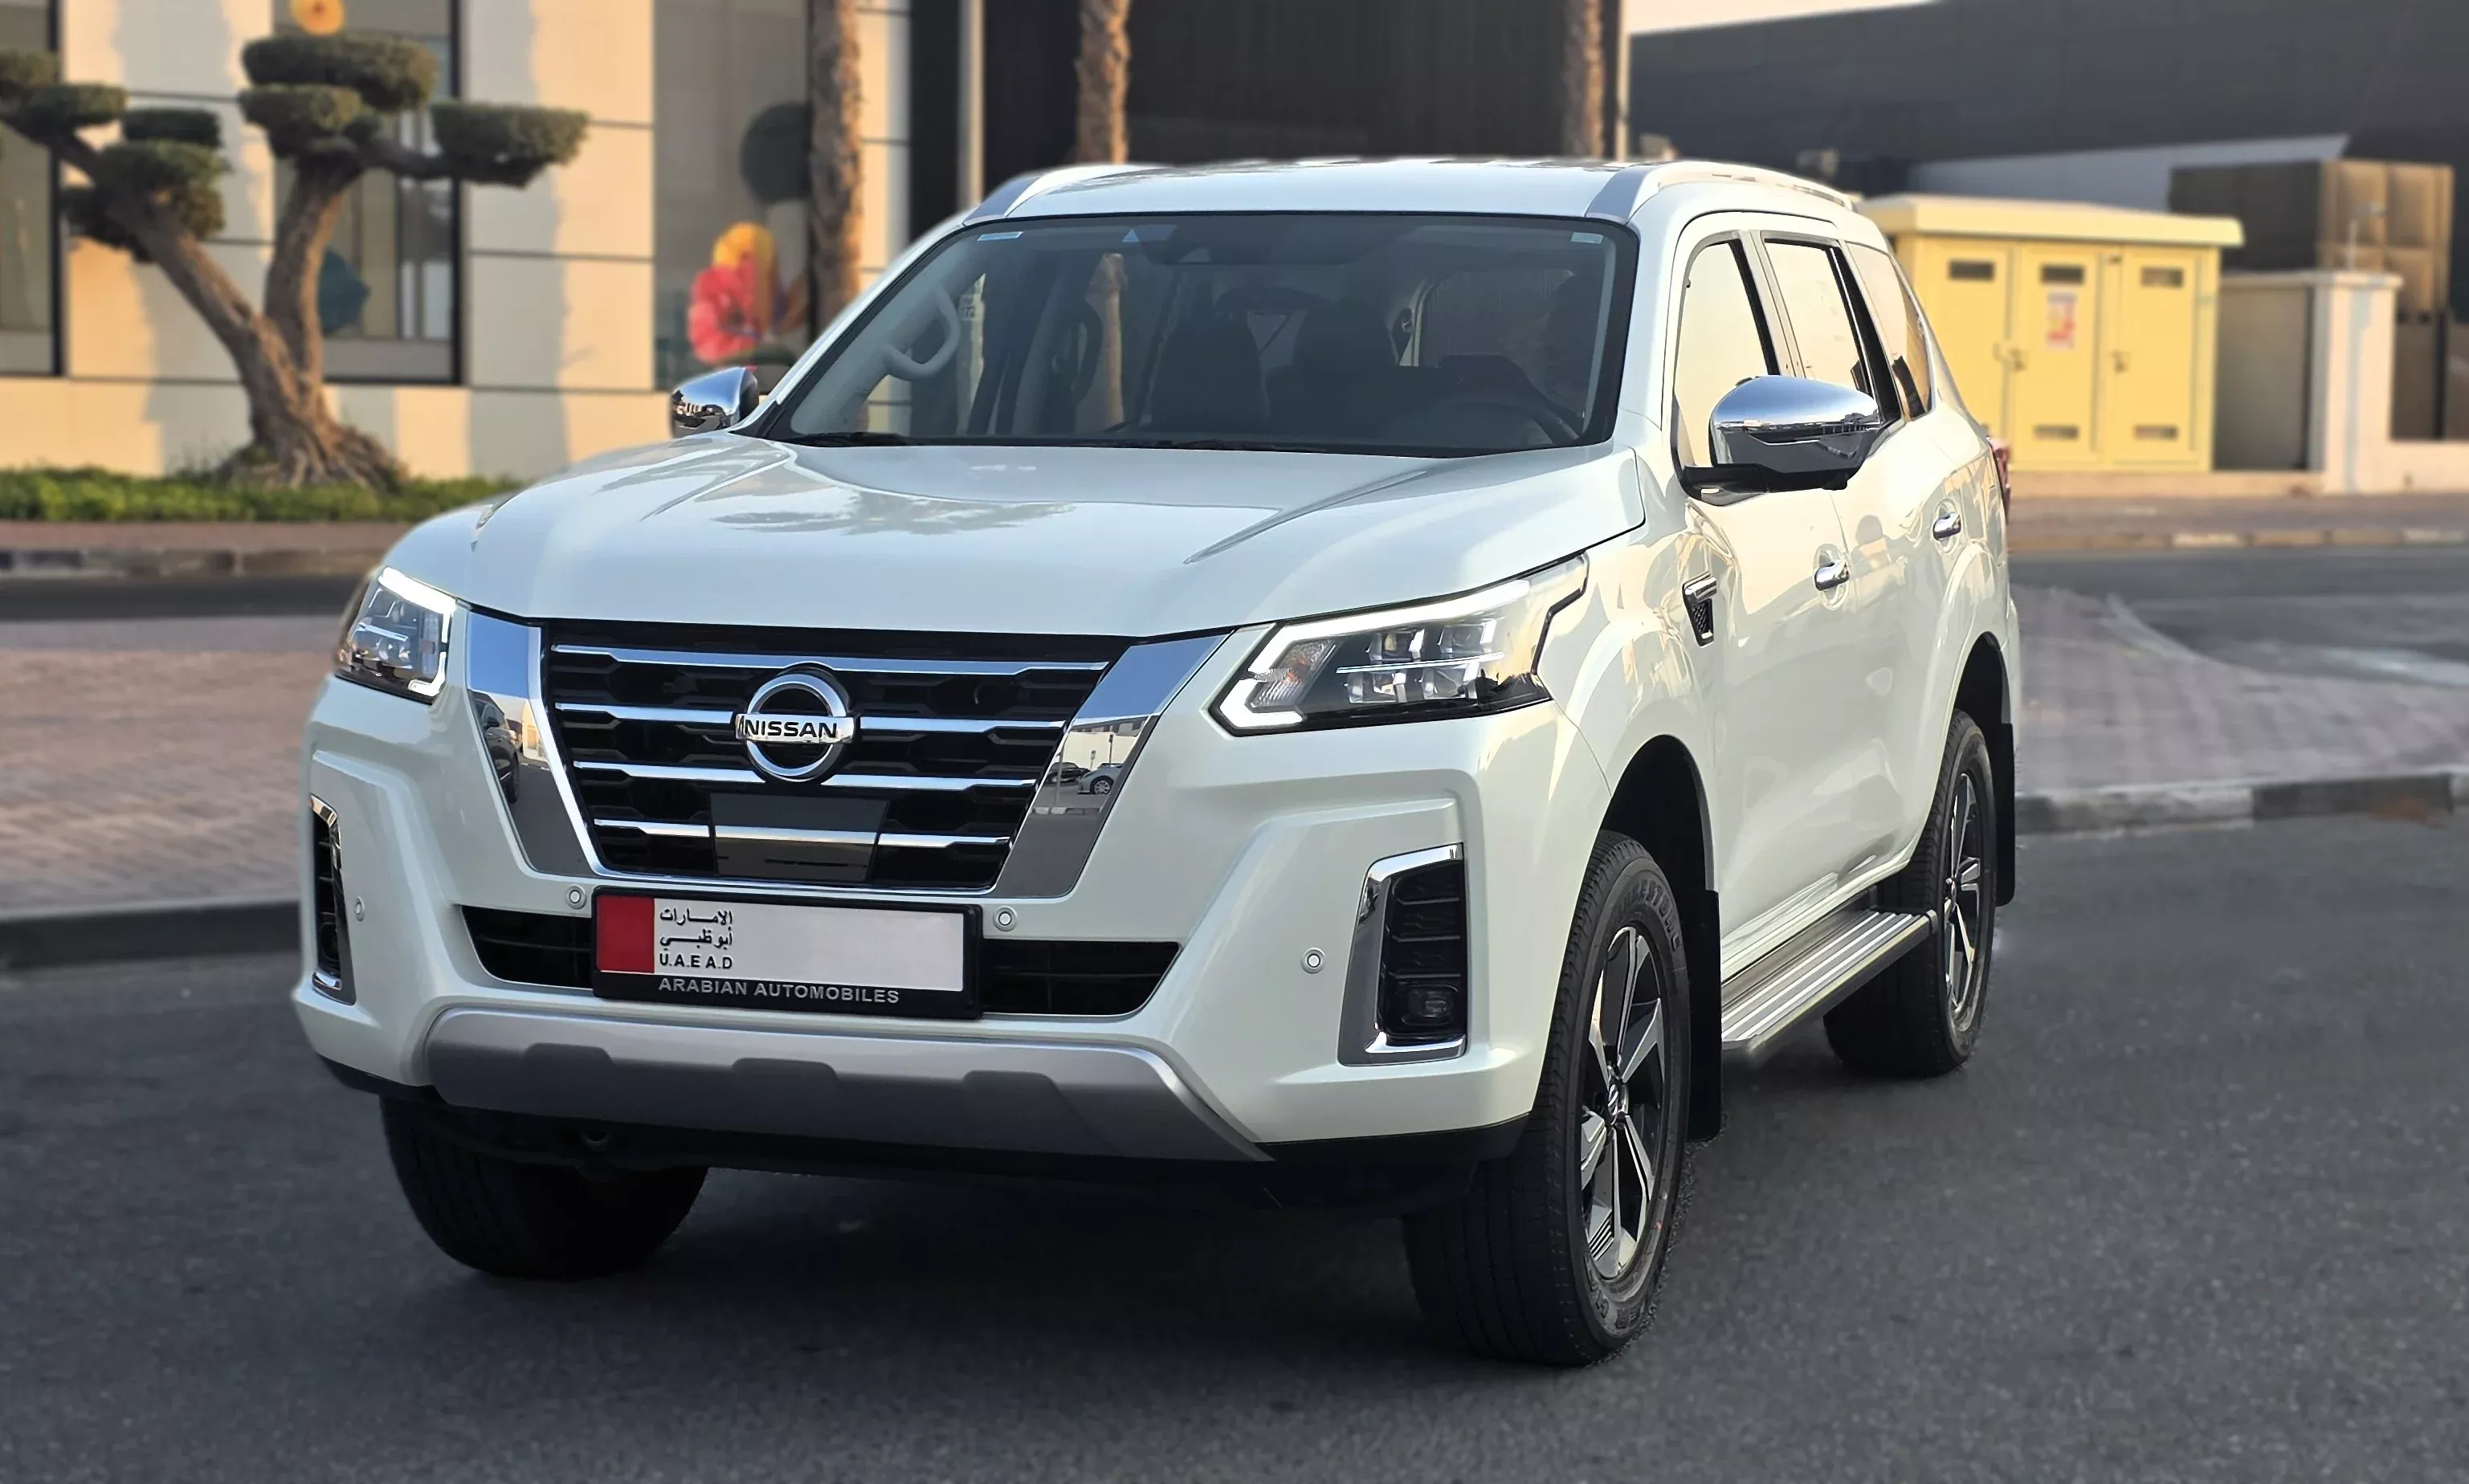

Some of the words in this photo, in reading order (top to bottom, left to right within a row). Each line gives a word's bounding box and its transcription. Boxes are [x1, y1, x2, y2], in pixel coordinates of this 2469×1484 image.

[744, 719, 838, 738] NISSAN
[658, 977, 748, 996] ARABIAN
[753, 983, 900, 1004] AUTOMOBILES
